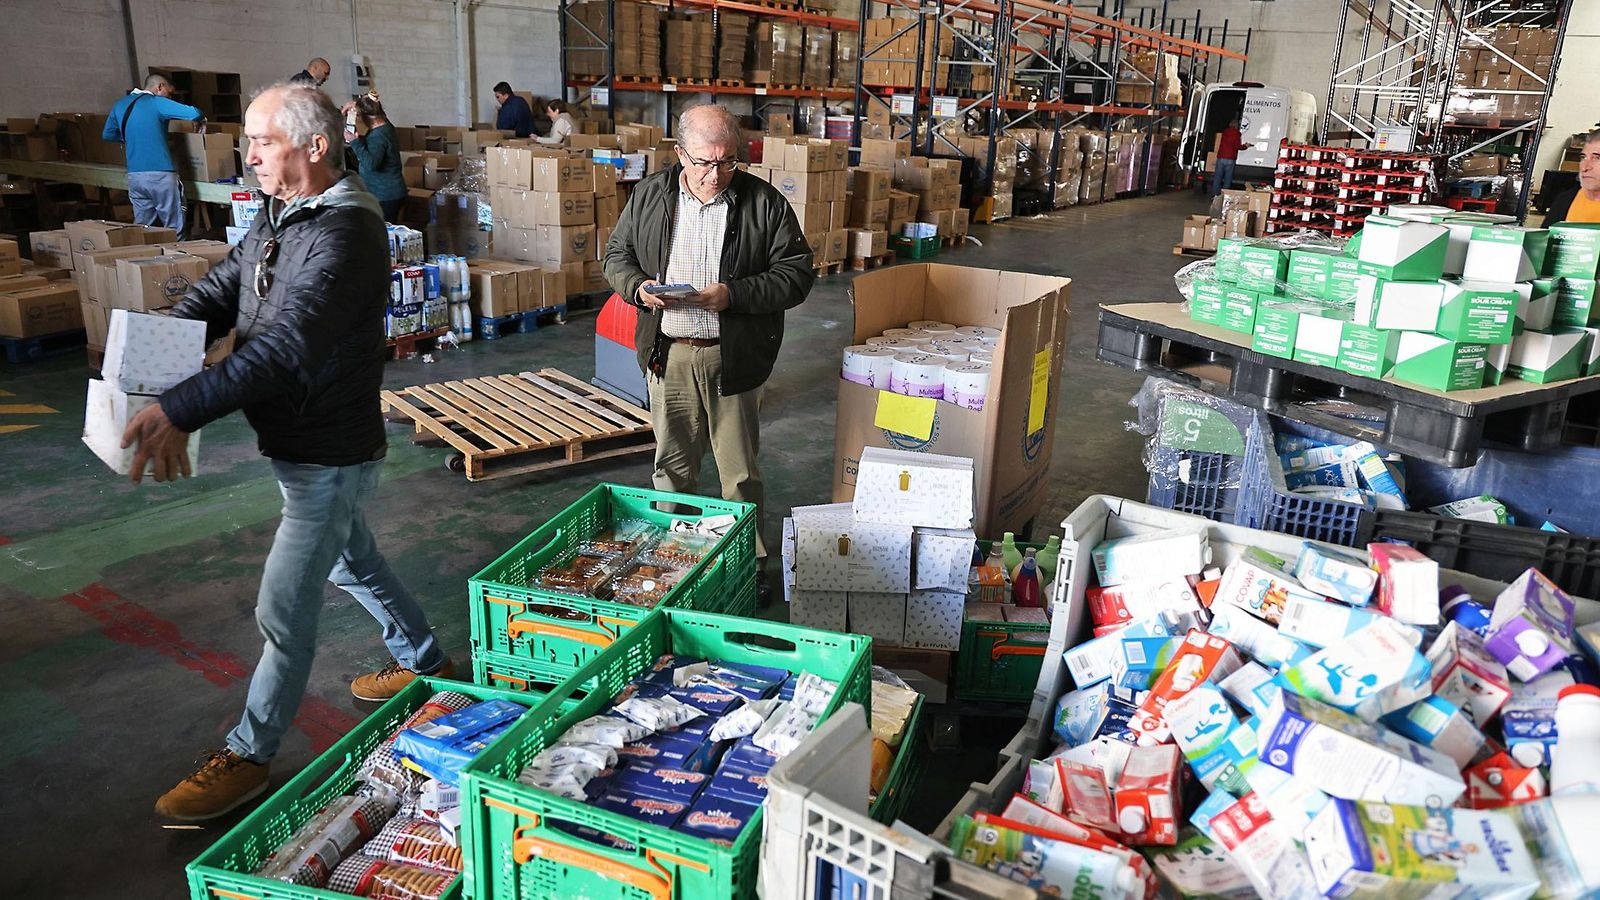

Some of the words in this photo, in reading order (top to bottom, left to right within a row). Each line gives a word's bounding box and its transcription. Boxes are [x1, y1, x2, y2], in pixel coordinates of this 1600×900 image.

[1246, 100, 1281, 108] ALIMENTOS
[1179, 407, 1209, 420] litros
[1184, 418, 1201, 442] 5
[688, 811, 741, 829] Cookies
